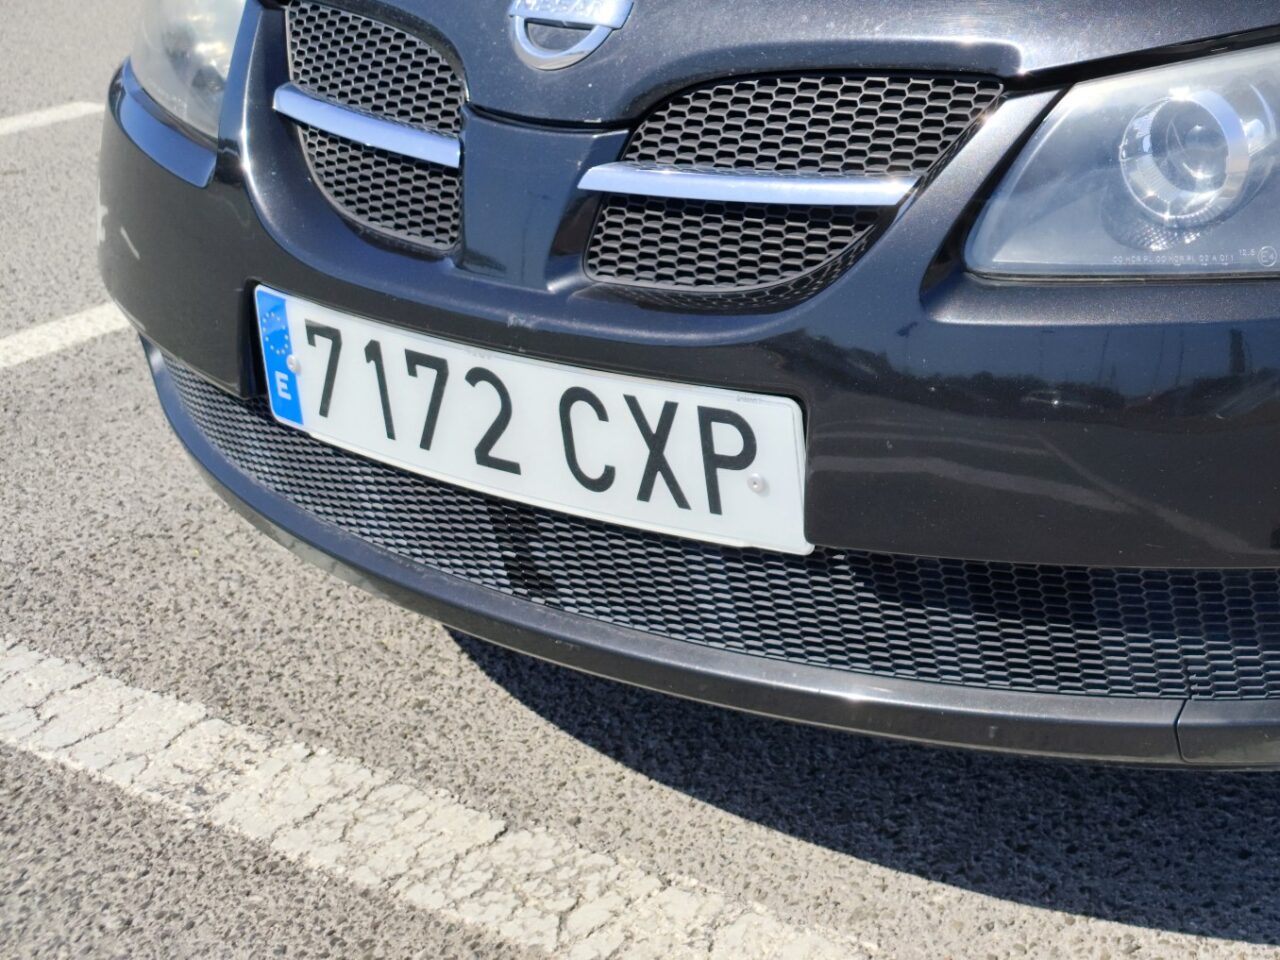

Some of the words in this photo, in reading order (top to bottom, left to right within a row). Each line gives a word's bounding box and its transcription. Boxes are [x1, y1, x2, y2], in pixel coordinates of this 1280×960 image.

[275, 370, 292, 400] E
[305, 319, 522, 476] 7172
[558, 386, 758, 515] CXP
